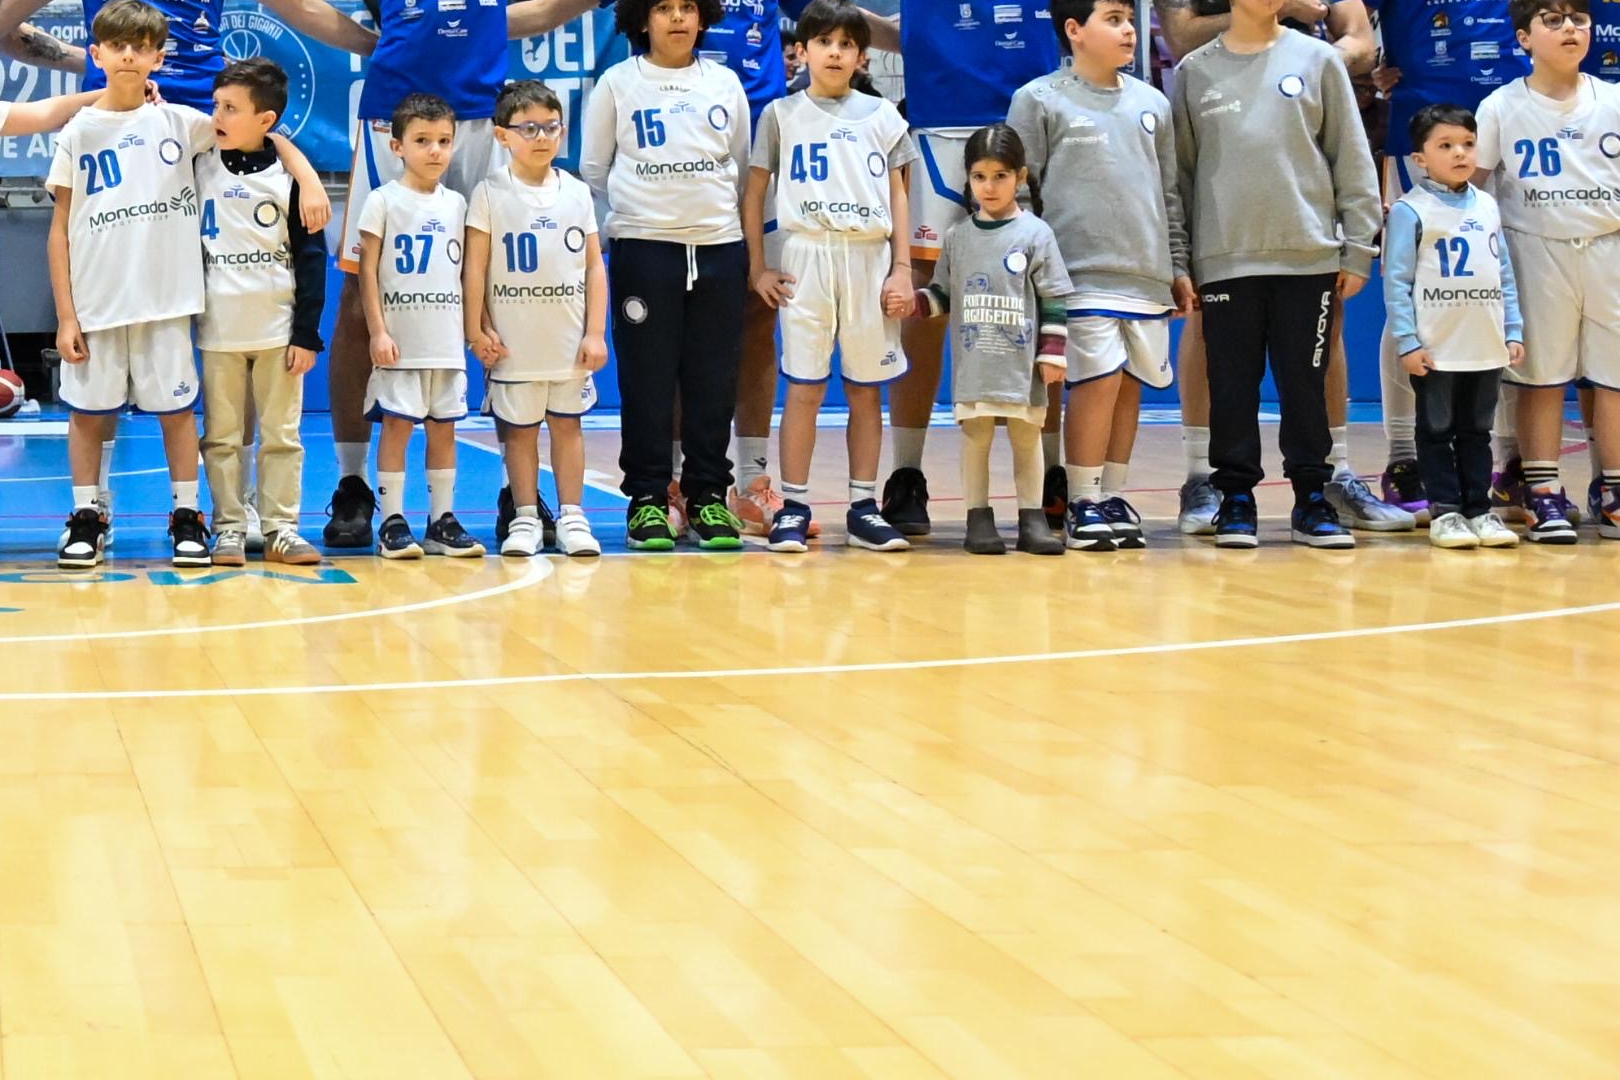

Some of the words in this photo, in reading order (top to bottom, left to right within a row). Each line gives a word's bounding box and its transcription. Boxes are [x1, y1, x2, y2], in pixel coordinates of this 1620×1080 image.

[230, 15, 246, 29] DEI
[248, 15, 284, 41] GIGANTI
[631, 108, 667, 149] 15
[78, 148, 123, 197] 20
[636, 157, 715, 176] Moncada
[790, 142, 829, 184] 45
[1514, 137, 1562, 179] 26
[89, 200, 168, 228] Moncada
[1523, 186, 1611, 202] Moncada
[394, 233, 434, 274] 37
[501, 232, 539, 273] 10
[1434, 236, 1474, 278] 12
[384, 291, 461, 306] Moncada
[493, 282, 575, 298] Moncada
[1423, 286, 1502, 301] Moncada
[1312, 291, 1332, 368] GIVOVA
